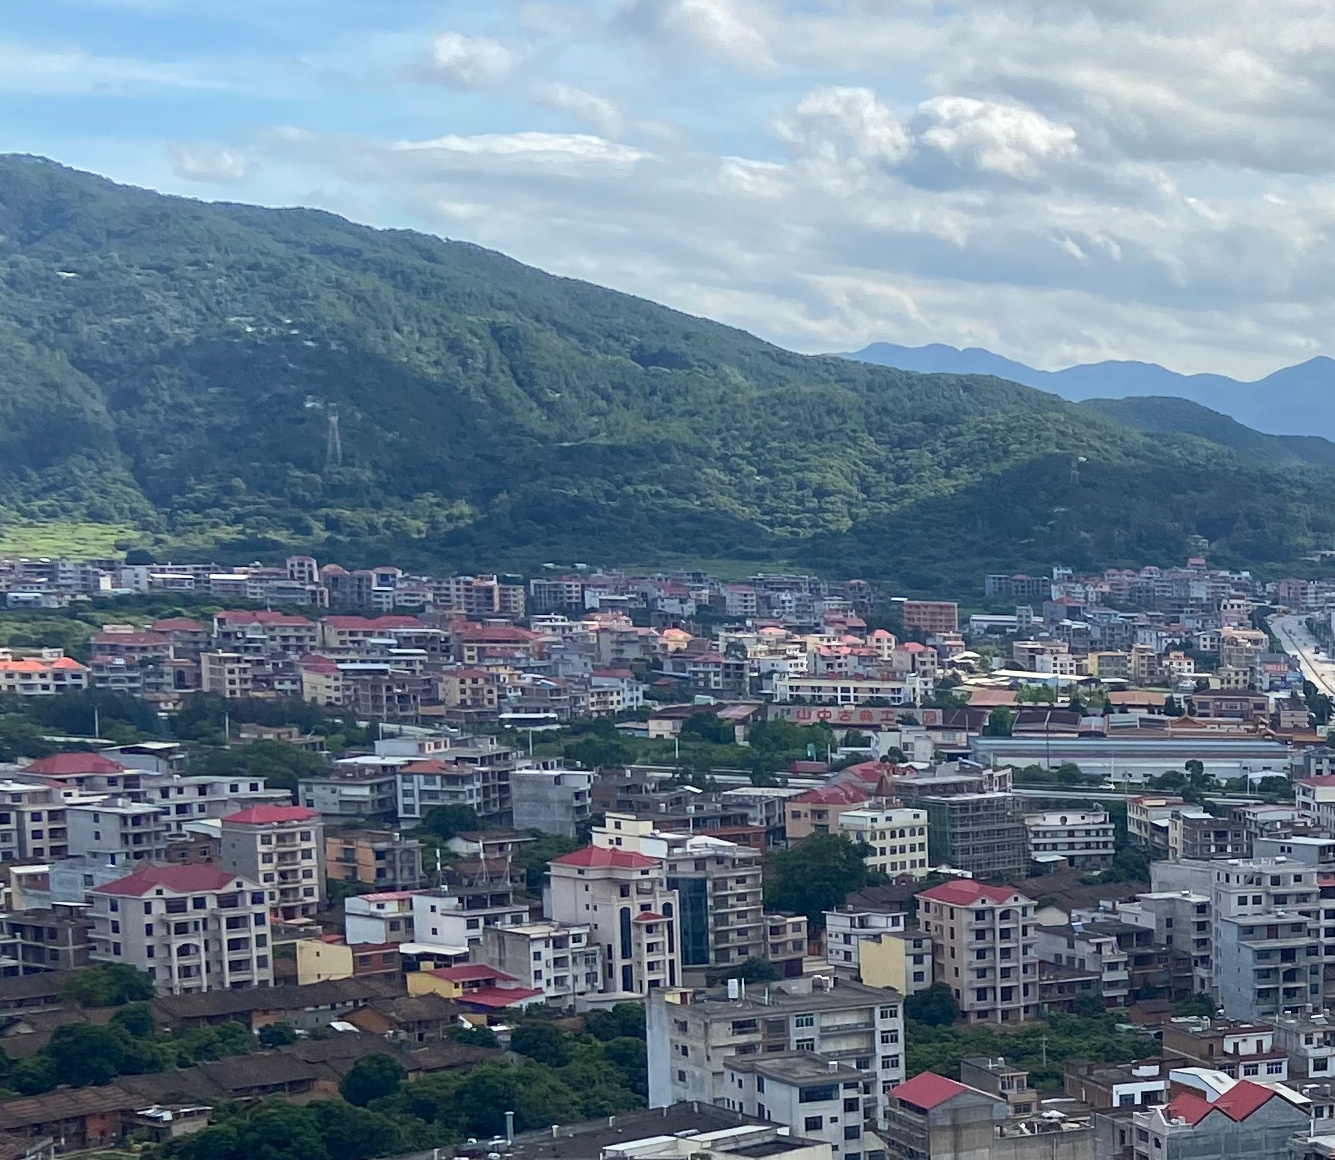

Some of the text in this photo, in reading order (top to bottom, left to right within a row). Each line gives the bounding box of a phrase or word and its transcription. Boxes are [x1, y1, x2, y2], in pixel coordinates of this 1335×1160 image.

[796, 707, 938, 724] 山中古典工园
